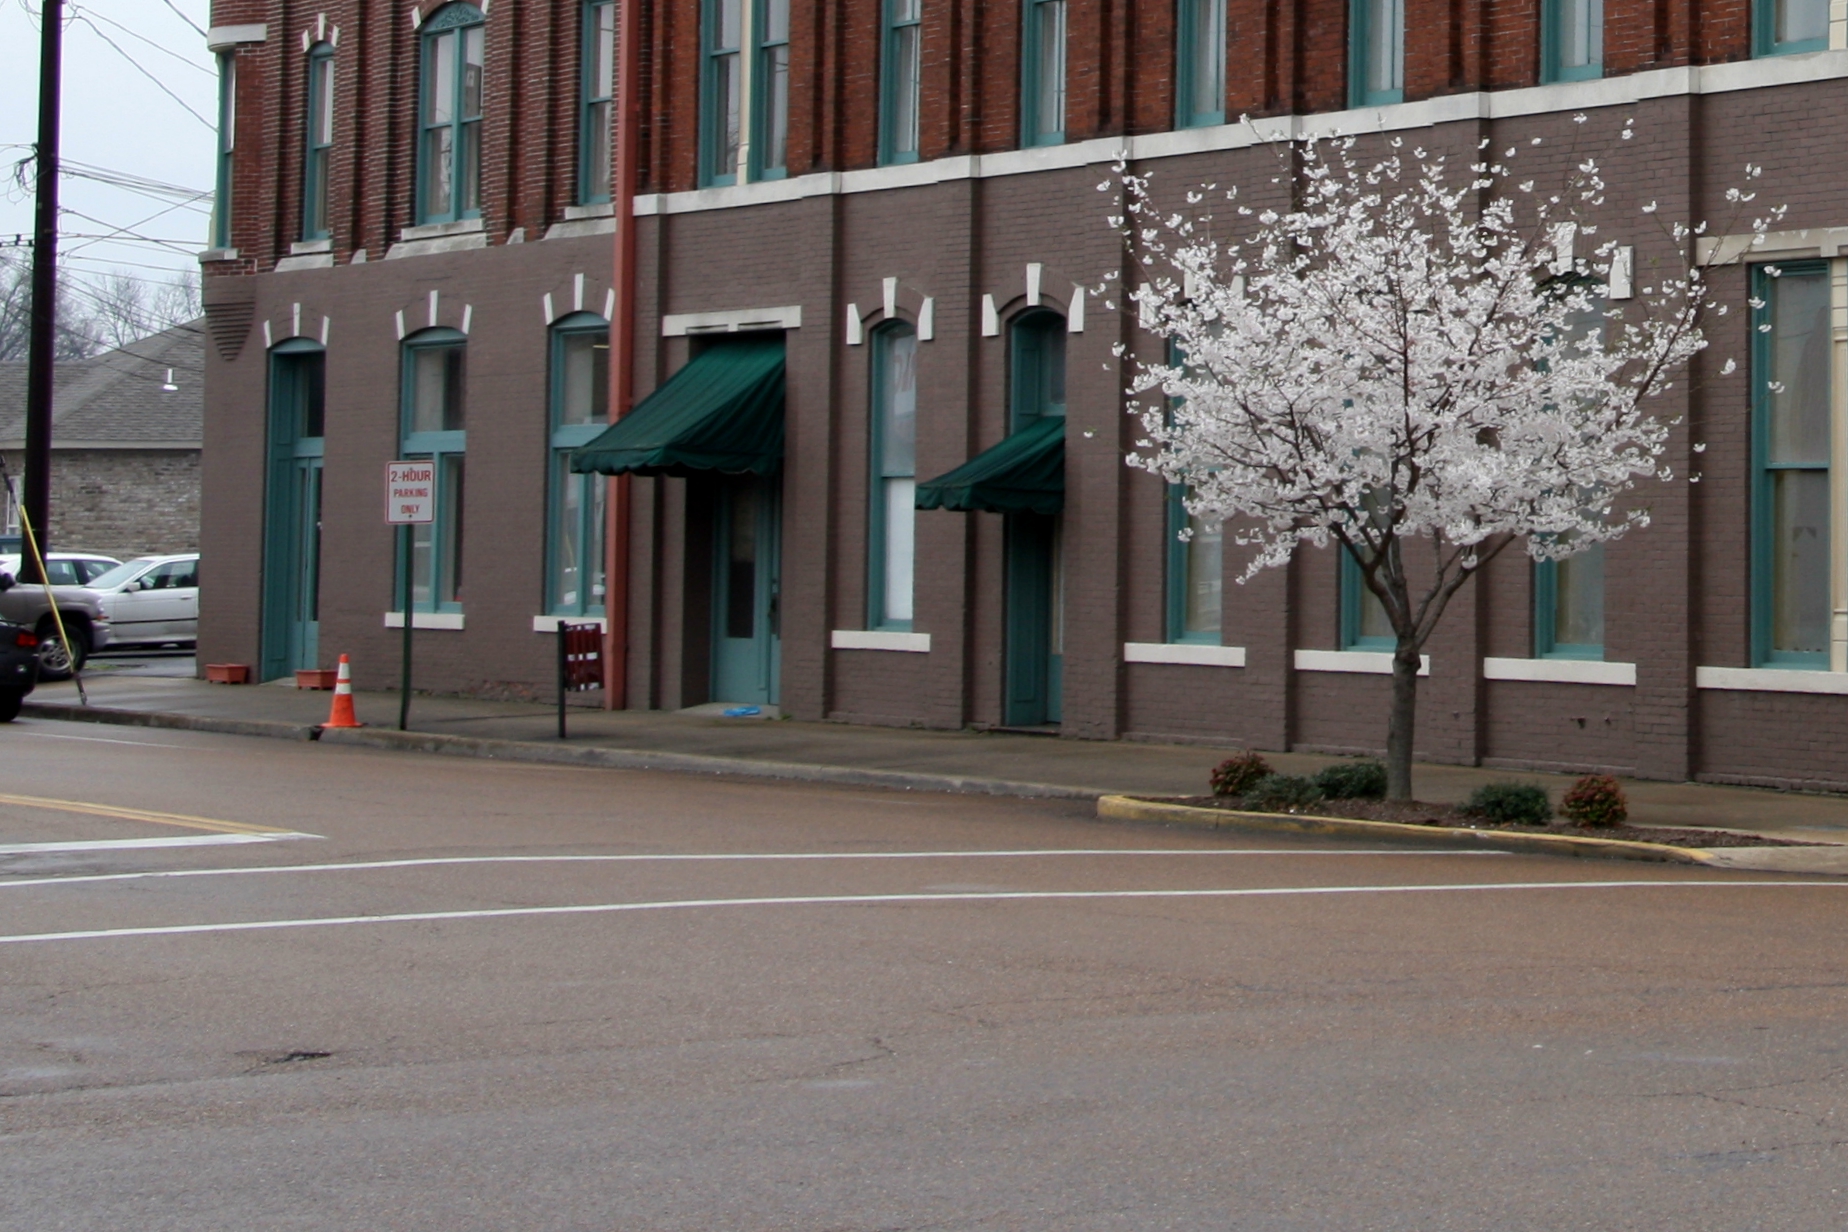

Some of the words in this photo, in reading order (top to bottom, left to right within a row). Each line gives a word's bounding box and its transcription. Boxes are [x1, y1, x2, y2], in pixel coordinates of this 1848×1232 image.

[391, 470, 431, 482] 2-HOUR
[394, 488, 428, 498] PARKING
[401, 504, 420, 514] ONLY
